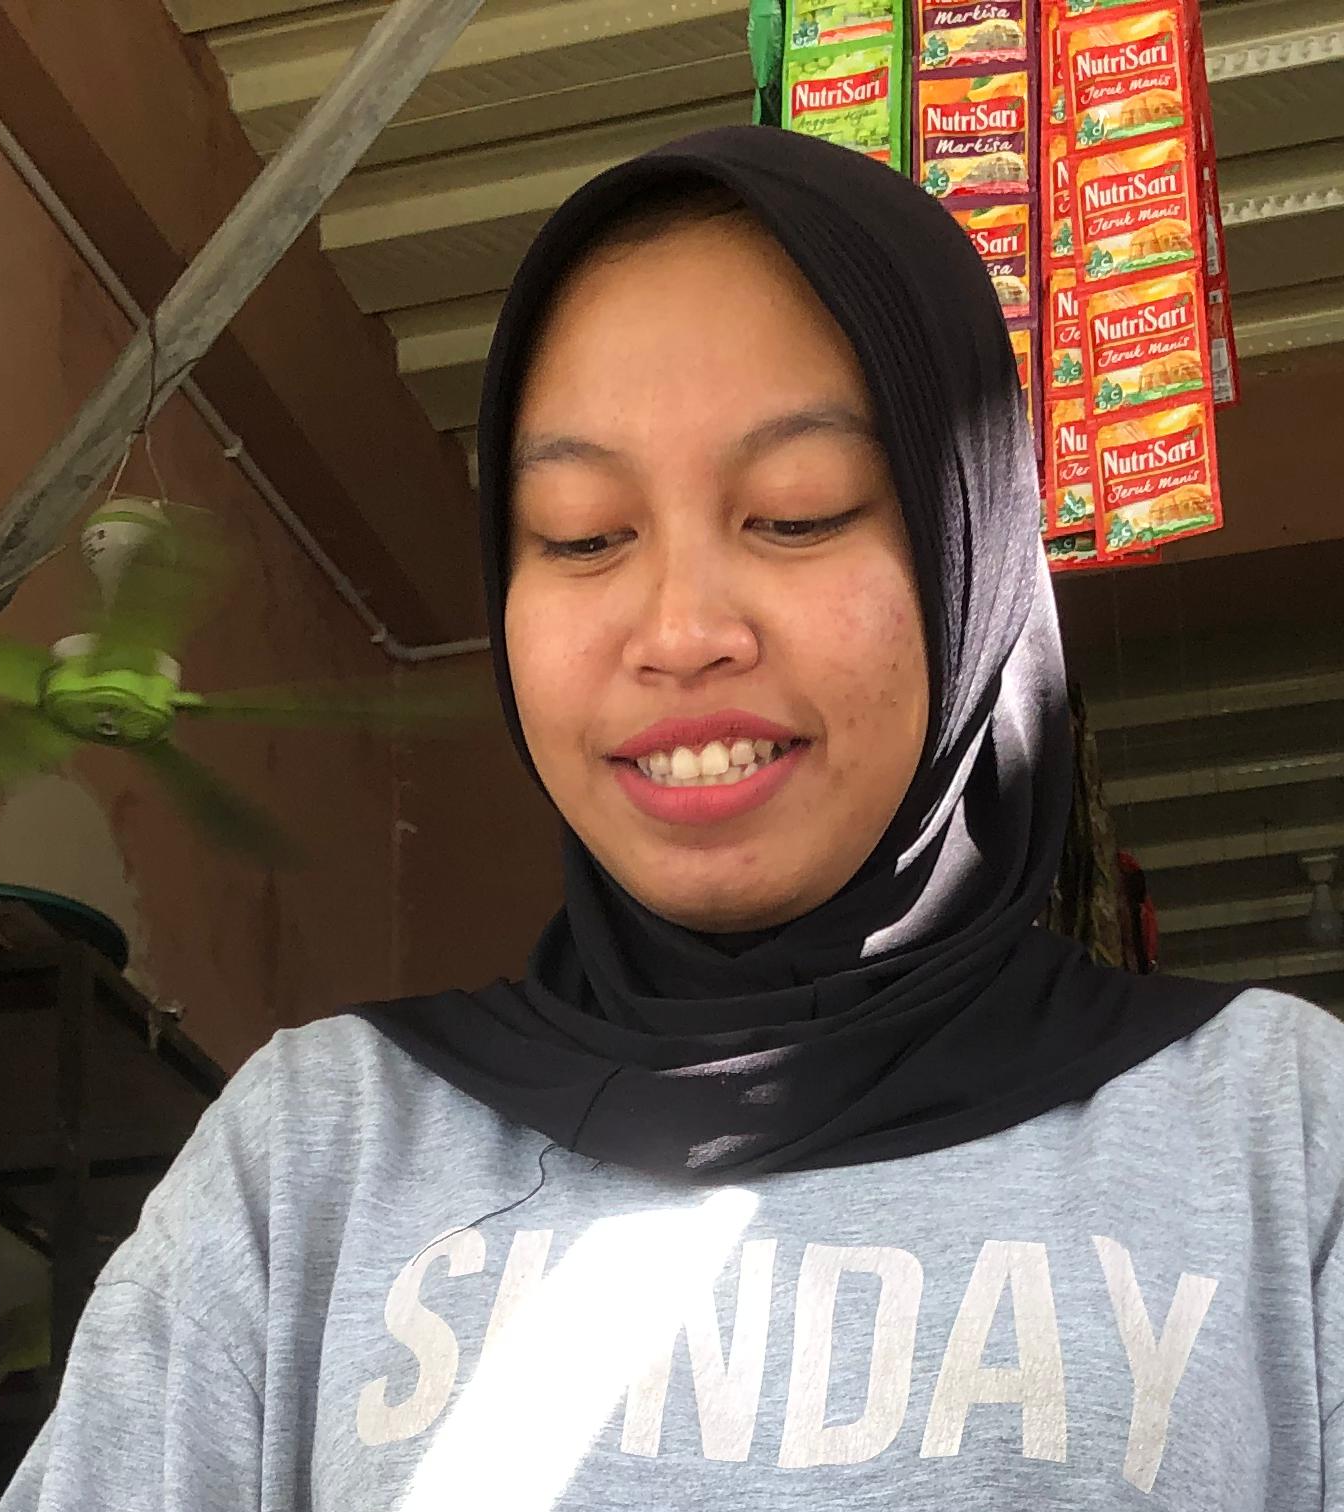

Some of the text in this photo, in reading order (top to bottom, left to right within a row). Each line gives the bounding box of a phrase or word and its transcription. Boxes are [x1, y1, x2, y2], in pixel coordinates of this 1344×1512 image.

[934, 4, 1010, 24] Markisa
[1076, 44, 1168, 81] NutriSari
[795, 79, 880, 110] NutriSari
[1081, 74, 1171, 105] Jeruk Manis
[927, 104, 1017, 131] NutriSari
[936, 137, 1012, 153] Markisa
[1084, 173, 1177, 211] NutriSari
[1088, 204, 1180, 236] Jeruk Manis
[1094, 306, 1187, 344] NutriSari
[1098, 336, 1190, 368] Jeruk Manis
[1103, 440, 1196, 478] NutriSari
[1107, 469, 1200, 503] Jeruk Manis
